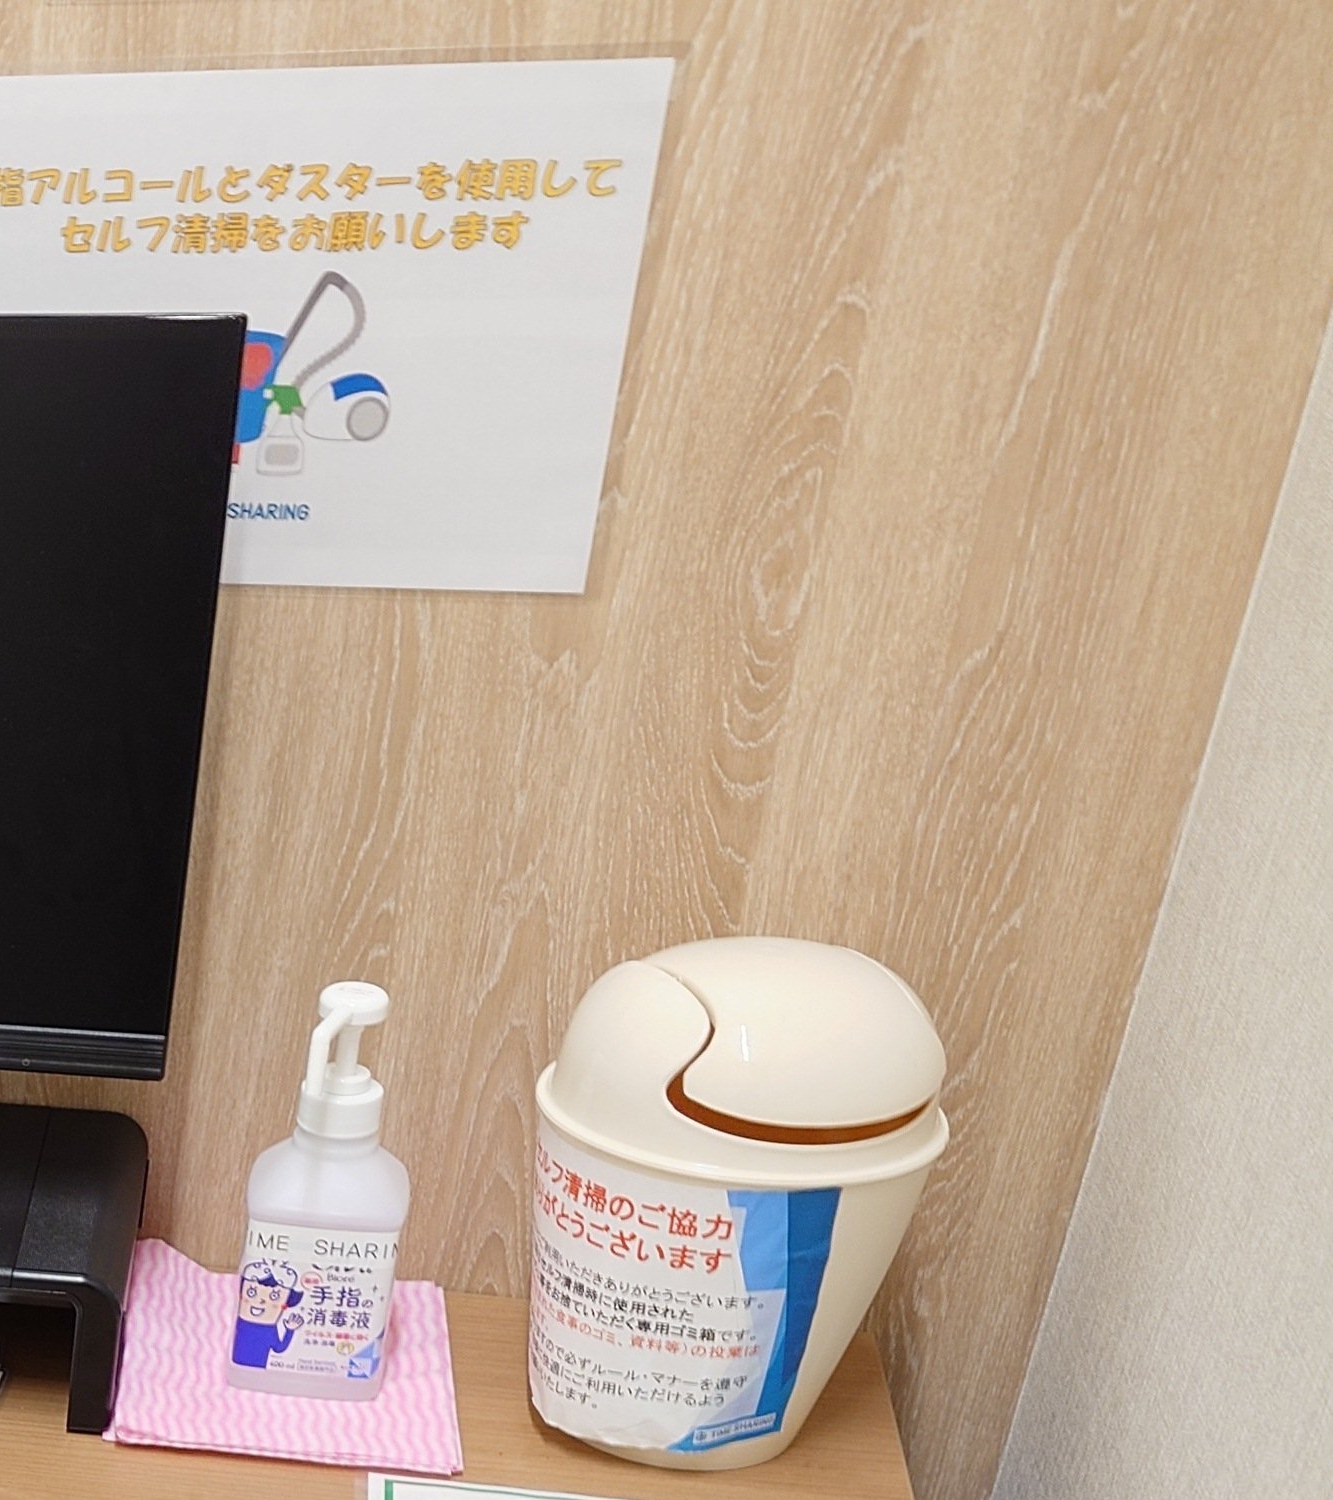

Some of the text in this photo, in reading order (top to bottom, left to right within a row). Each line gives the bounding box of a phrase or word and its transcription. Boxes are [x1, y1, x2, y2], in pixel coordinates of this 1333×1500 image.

[60, 210, 530, 253] セルフ清掃をお願いします
[226, 502, 310, 520] SHARING
[309, 1286, 374, 1308] 手指の
[307, 1308, 371, 1329] 消毒液
